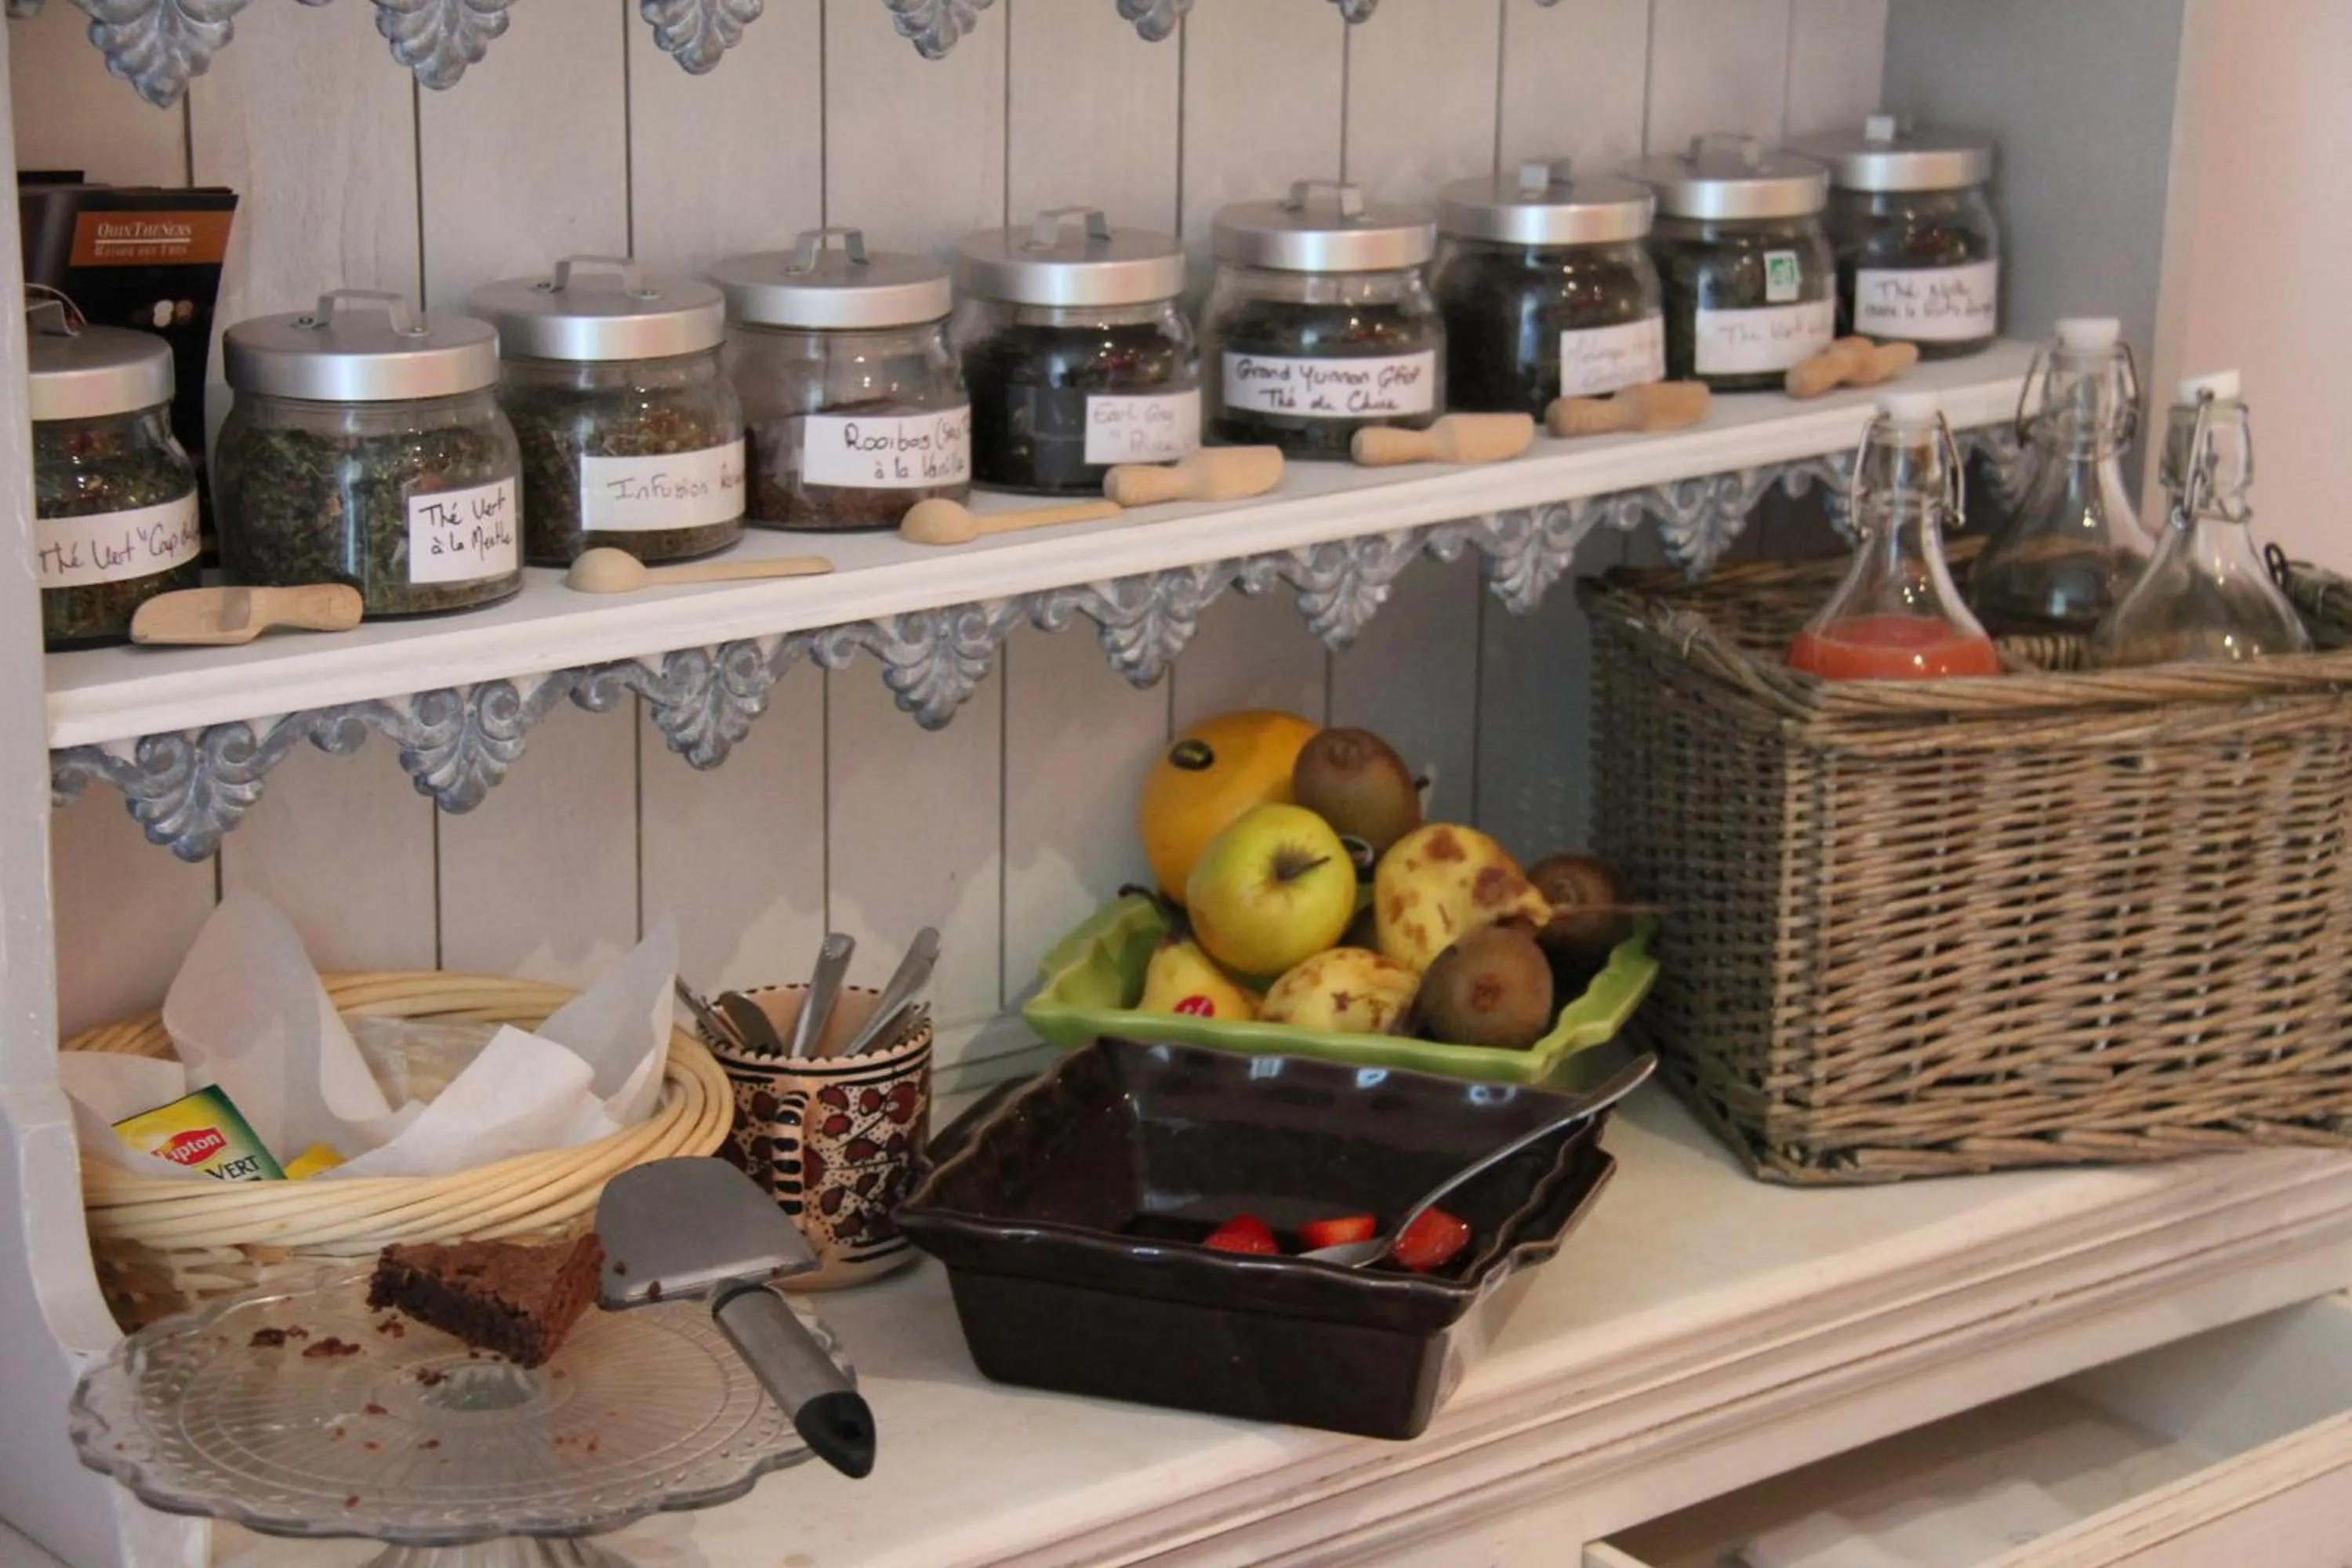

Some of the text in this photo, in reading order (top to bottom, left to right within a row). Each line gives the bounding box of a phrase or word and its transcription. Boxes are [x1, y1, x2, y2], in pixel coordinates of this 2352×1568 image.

[874, 461, 885, 480] à
[418, 486, 506, 528] Thé Vert
[38, 540, 85, 575] Thé
[92, 530, 136, 570] Vert
[431, 536, 445, 555] à
[448, 531, 465, 552] la
[204, 1156, 260, 1179] VERT
